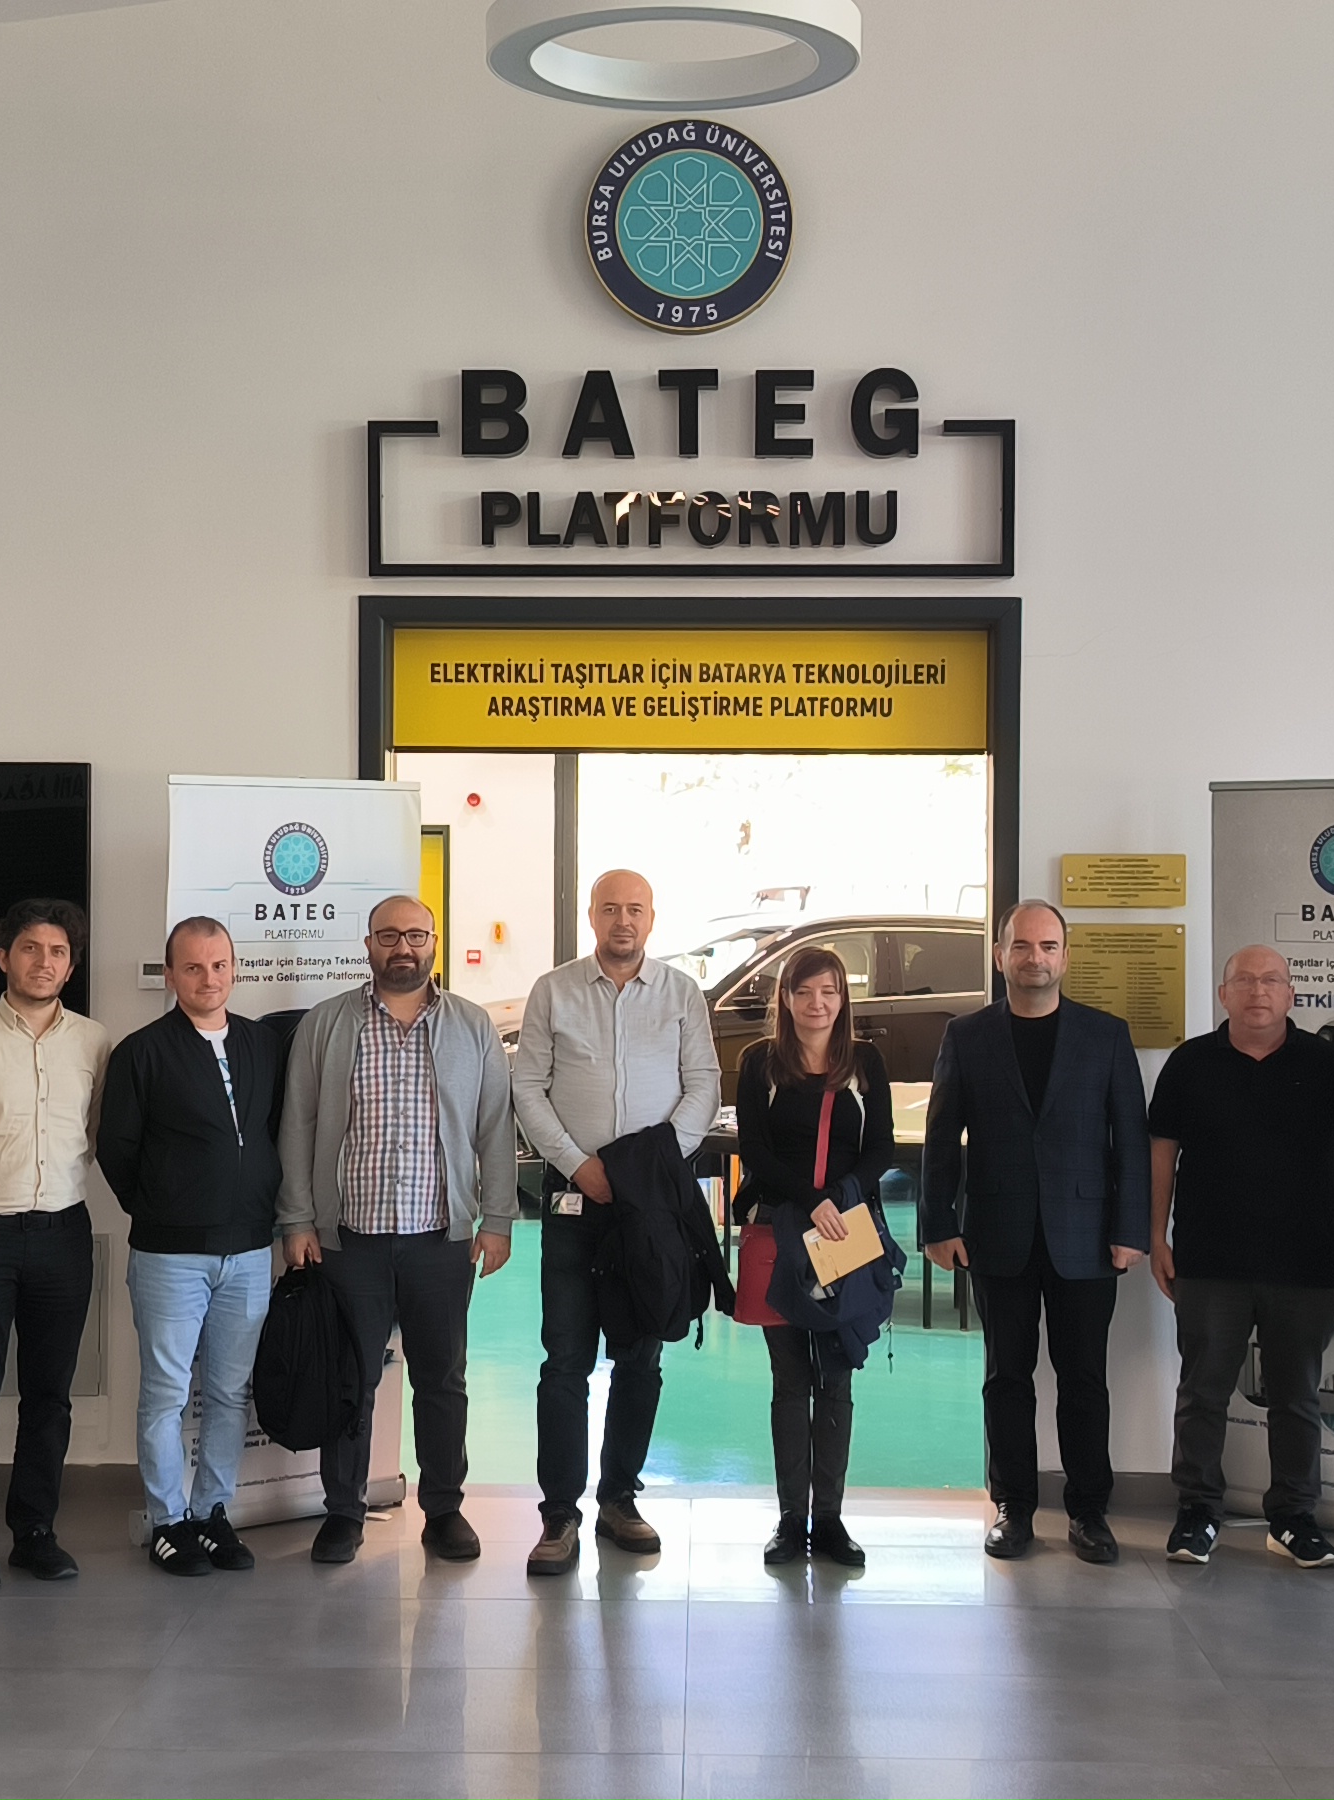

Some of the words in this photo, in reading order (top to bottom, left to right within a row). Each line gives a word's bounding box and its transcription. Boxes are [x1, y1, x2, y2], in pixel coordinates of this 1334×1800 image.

[591, 183, 616, 261] BURSA
[608, 121, 697, 179] ULUDAĞ
[704, 124, 789, 262] ÜNİVERSİTESİ
[655, 302, 718, 324] 1975
[460, 366, 919, 459] BATEG
[480, 490, 899, 549] PLATFORMU
[430, 658, 544, 684] ELEKTRİKLİ
[551, 662, 644, 690] TAŞITLAR
[651, 658, 693, 690] İÇİN
[698, 663, 787, 684] BATARYA
[792, 658, 947, 689] TEKNOLOJİLERİ
[487, 696, 606, 723] ARAŞTIRMA
[612, 696, 637, 717] VE
[643, 691, 764, 723] GELİŞTİRME
[770, 696, 894, 718] PLATFORMU
[264, 844, 273, 873] BURSA
[270, 823, 300, 844] ULUDAĞ
[254, 903, 335, 921] BATEG
[264, 929, 325, 939] PLATFORMU
[262, 974, 274, 982] ve
[276, 972, 324, 983] Geliştirme
[326, 971, 371, 980] Platformu
[296, 957, 332, 968] Batarya
